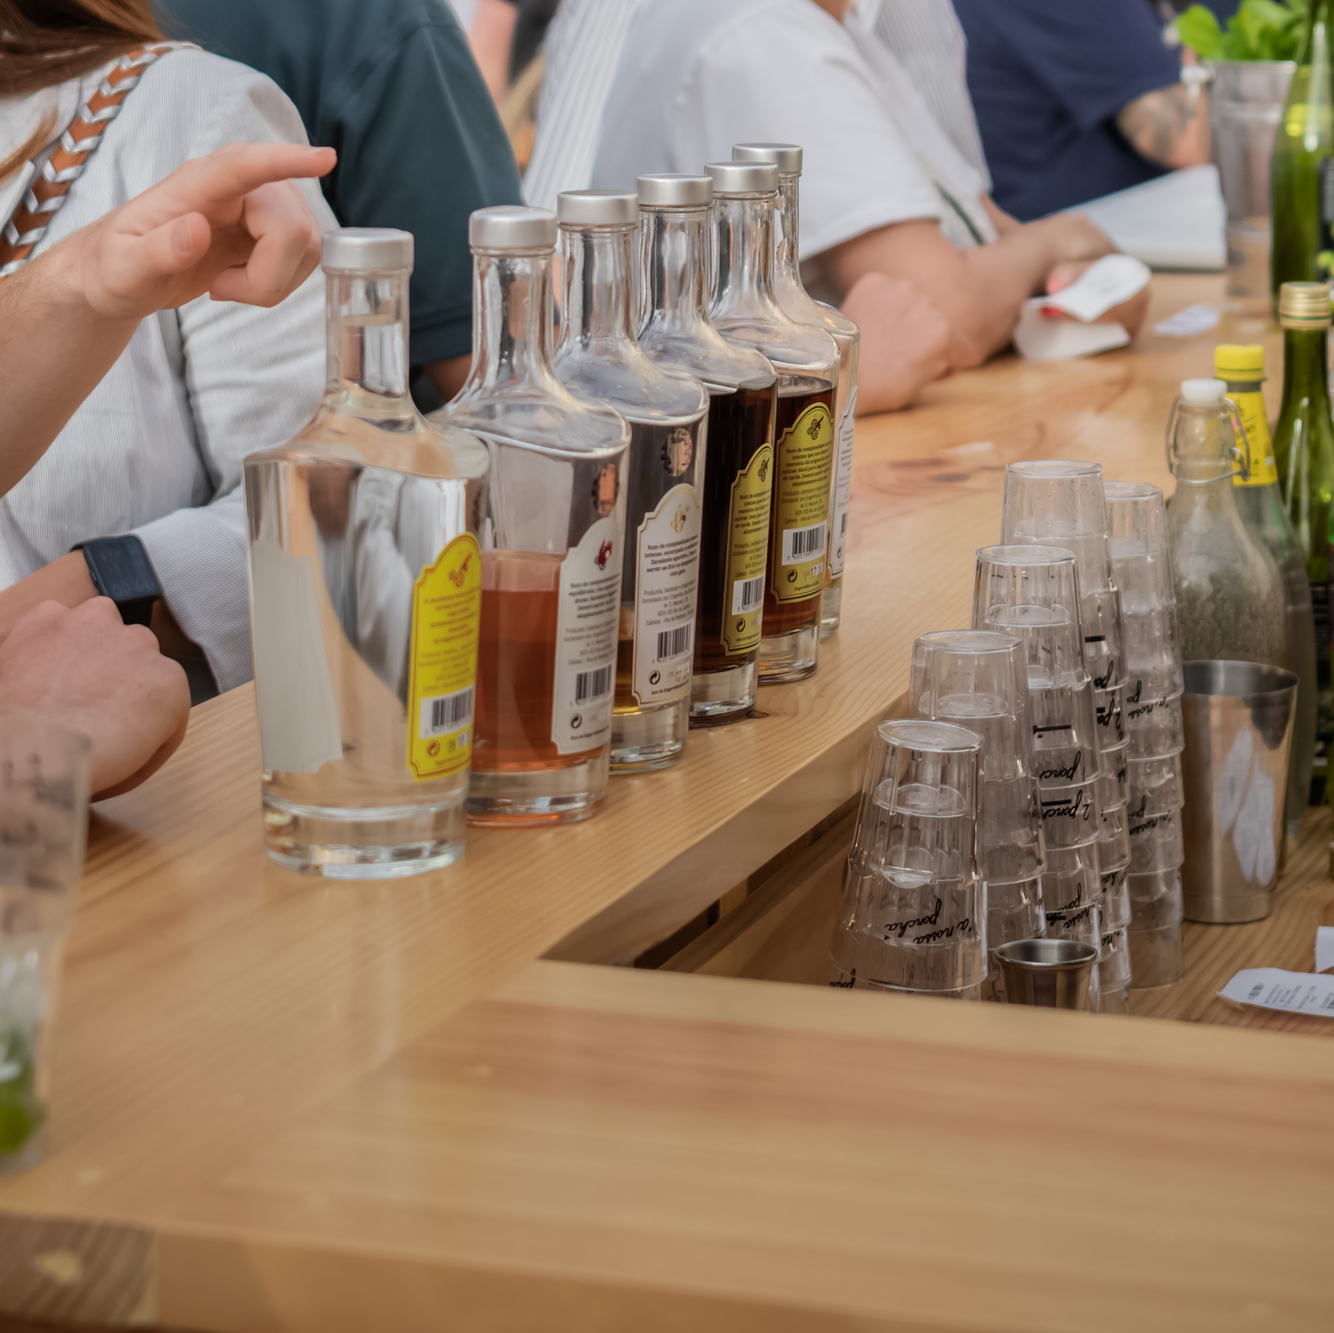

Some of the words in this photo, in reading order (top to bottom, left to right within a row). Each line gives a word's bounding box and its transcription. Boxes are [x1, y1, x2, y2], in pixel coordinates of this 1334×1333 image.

[1128, 704, 1153, 719] noss
[1039, 750, 1081, 781] ponc
[1043, 789, 1083, 820] ponc
[913, 926, 954, 944] nossa
